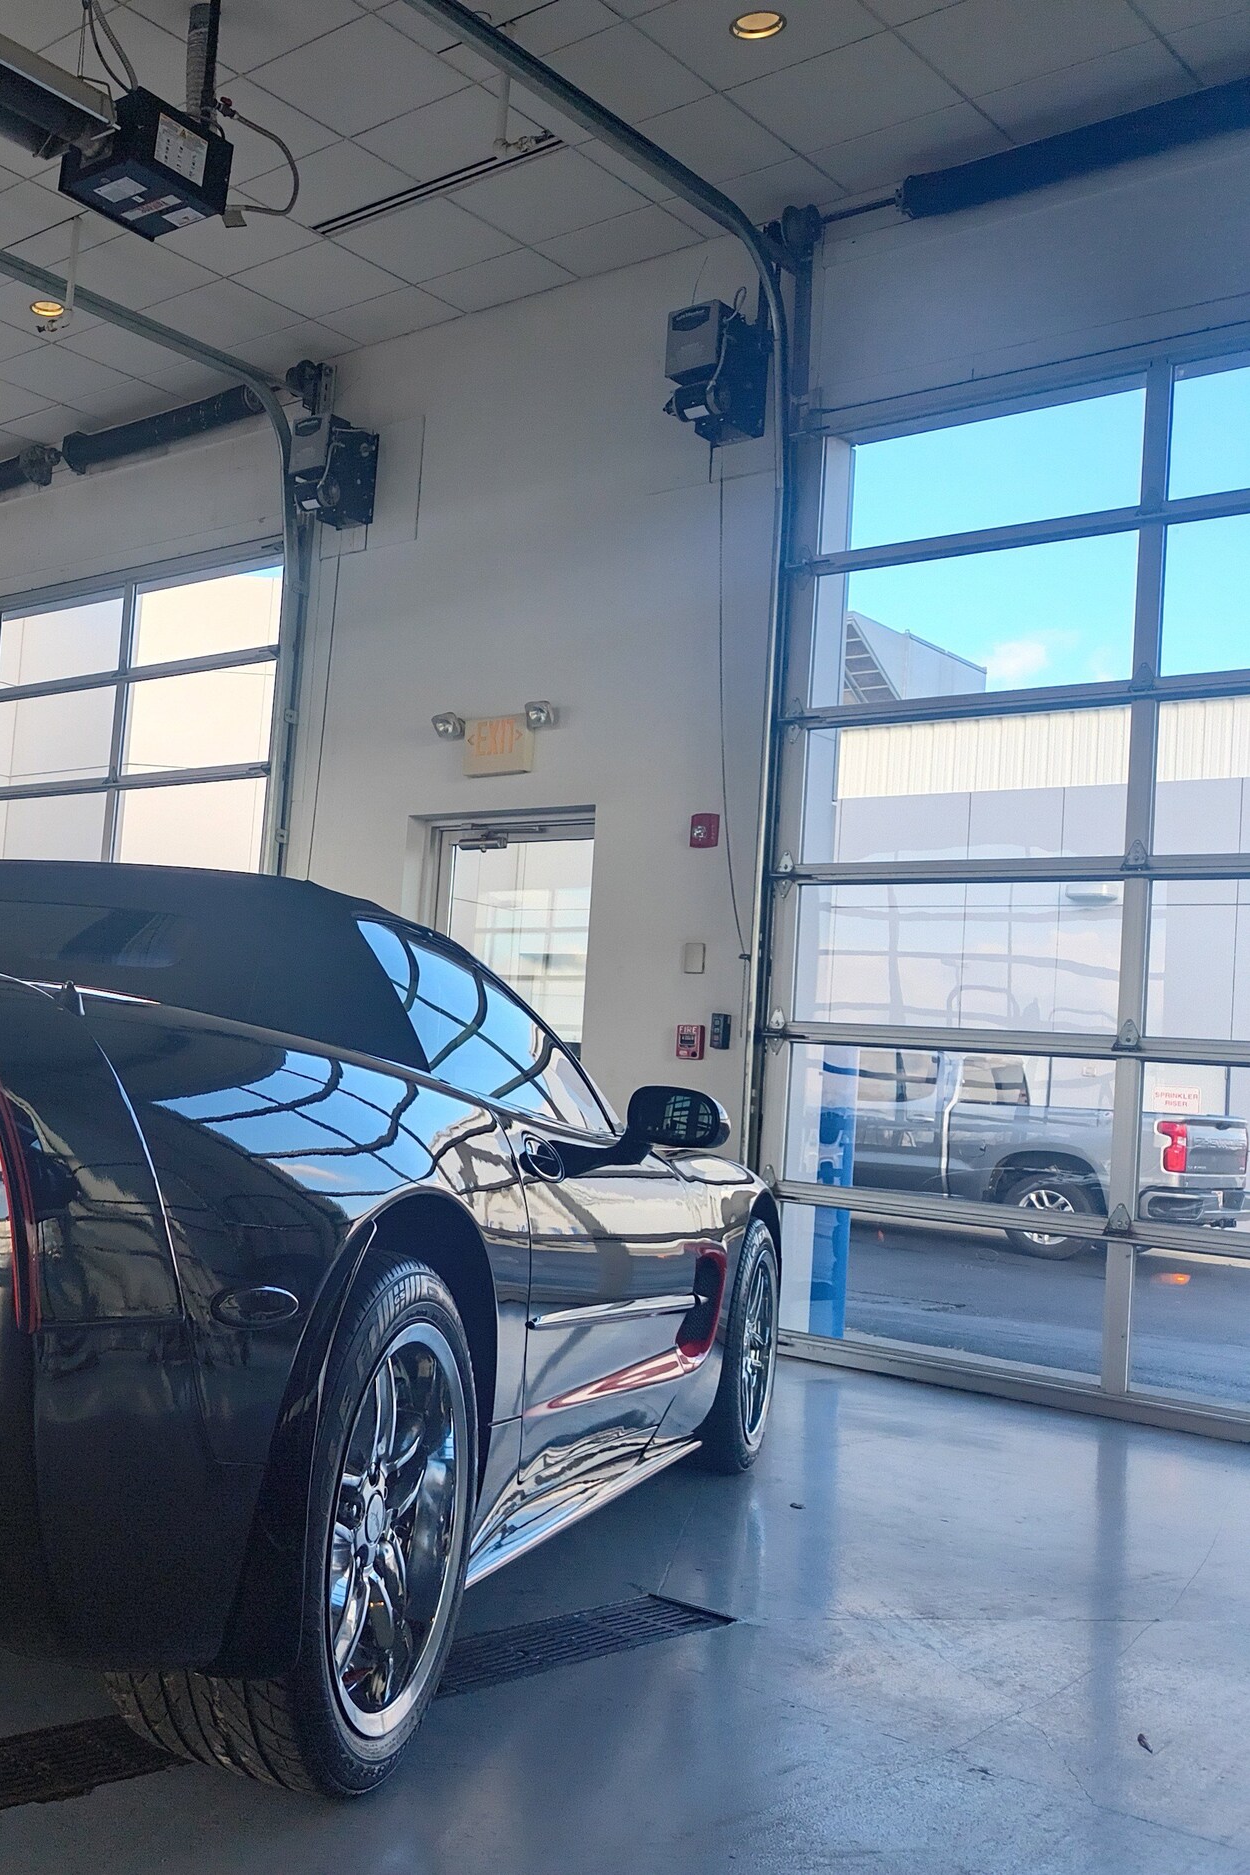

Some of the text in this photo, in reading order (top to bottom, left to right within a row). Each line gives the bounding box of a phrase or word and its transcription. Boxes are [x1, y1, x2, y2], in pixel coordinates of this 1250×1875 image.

[476, 717, 516, 755] EXIT
[679, 1025, 698, 1034] FIRE
[1154, 1092, 1199, 1100] SPRINKLER
